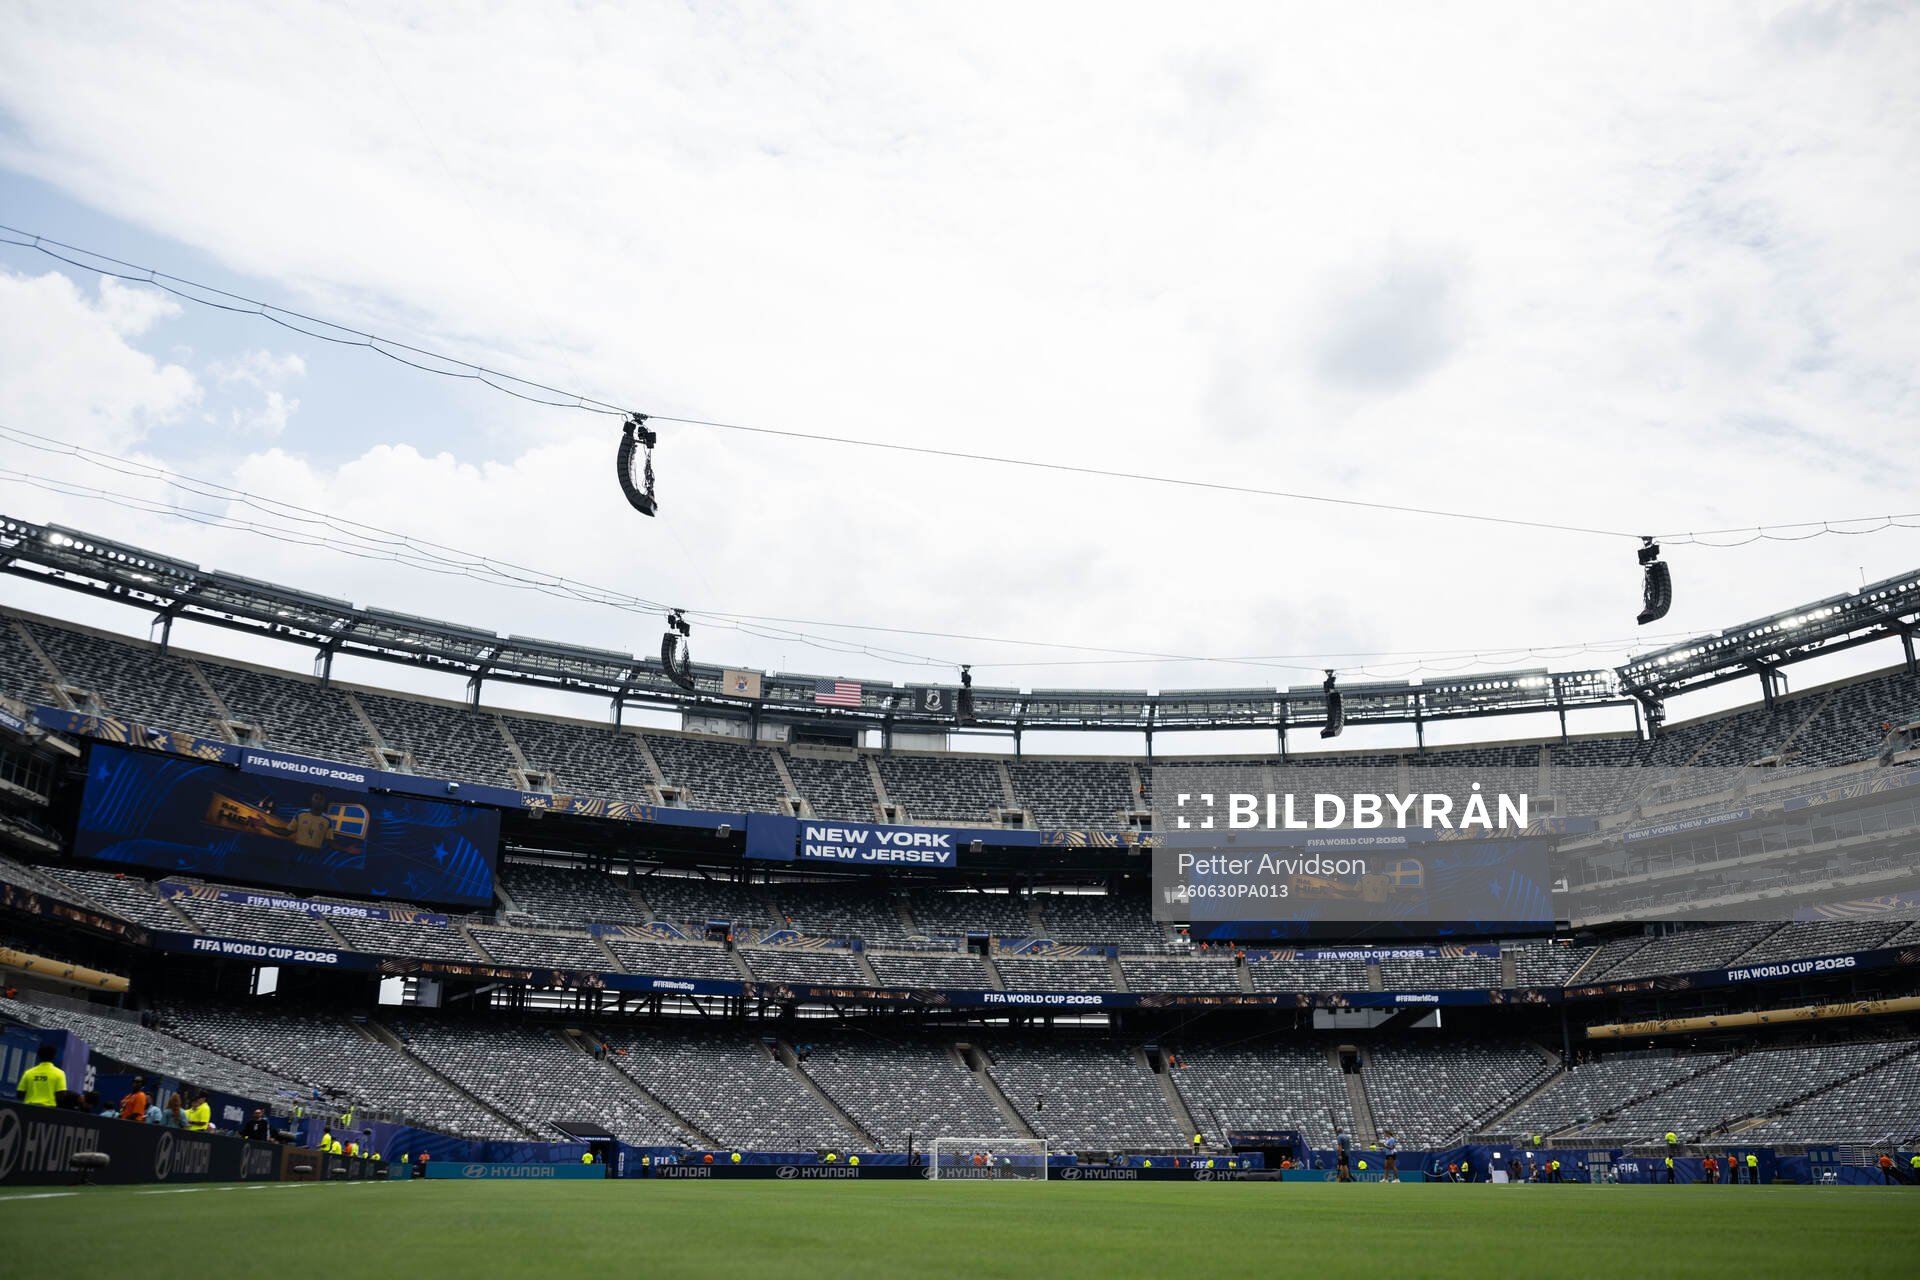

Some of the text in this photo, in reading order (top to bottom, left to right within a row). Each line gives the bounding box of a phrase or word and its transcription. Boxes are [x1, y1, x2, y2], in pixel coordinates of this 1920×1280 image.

[247, 755, 365, 783] FIFA WORLD CUP 2026
[1628, 811, 1744, 840] NEW YORK NEW JERSEY
[806, 827, 950, 848] NEW YORK
[1307, 836, 1406, 847] FIFA WORLD CUP 2026
[805, 844, 950, 863] NEW JERSEY
[247, 896, 271, 908] FIFA
[271, 898, 309, 912] WORLD
[310, 902, 332, 914] CUP
[332, 905, 367, 917] 2026
[193, 939, 338, 964] FIFA WORLD CUP 2026
[1318, 951, 1337, 960] FIFA
[1338, 950, 1371, 959] WORLD
[1372, 950, 1391, 959] CUP
[1391, 949, 1425, 958] 2026
[1727, 956, 1856, 981] FIFA WORLD CUP 2026
[984, 993, 1103, 1005] FIFA WORLD CUP 2026
[21, 1121, 100, 1172] HYUNDAI
[654, 1157, 677, 1166] FIF
[1191, 1160, 1210, 1169] FIF
[491, 1166, 555, 1177] HYUNDAI
[802, 1168, 860, 1178] HYUNDAI
[1084, 1169, 1137, 1179] HYUNDAI
[1620, 1163, 1639, 1173] FIFA
